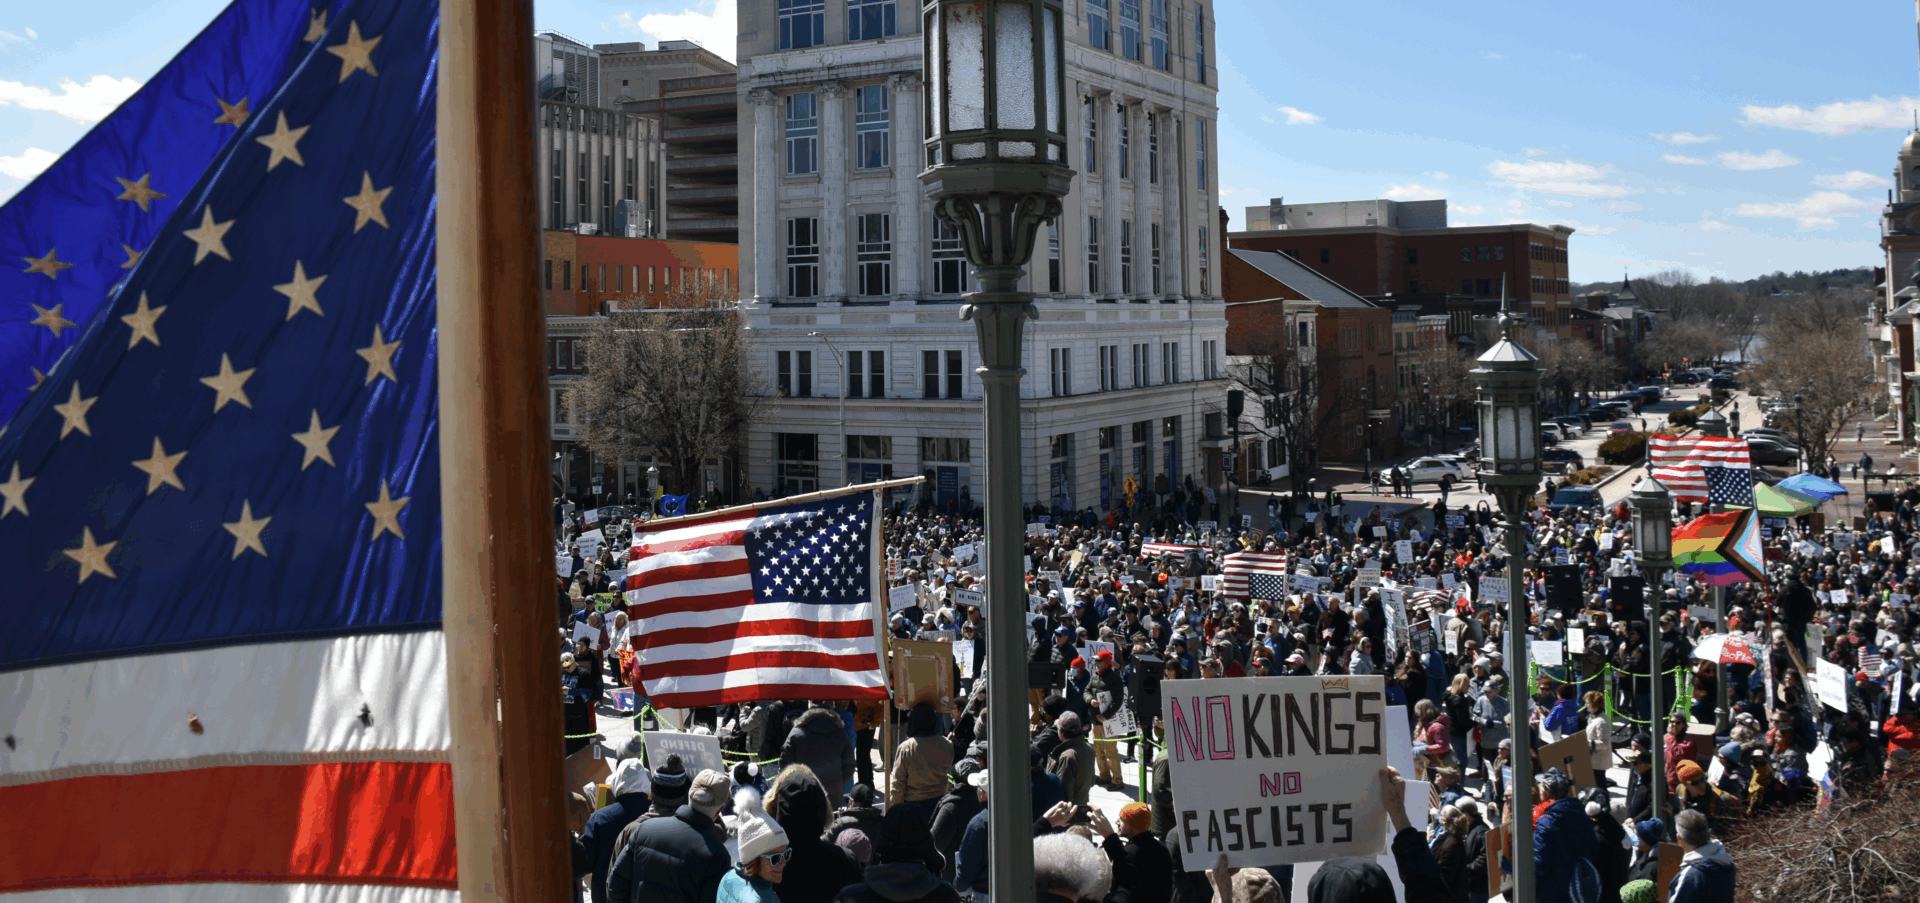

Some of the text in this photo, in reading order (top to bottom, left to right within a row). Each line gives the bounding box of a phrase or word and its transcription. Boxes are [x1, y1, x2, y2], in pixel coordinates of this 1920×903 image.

[1171, 691, 1381, 762] NO KINGS
[1260, 772, 1301, 797] NO
[1182, 803, 1353, 853] FASCISTS
